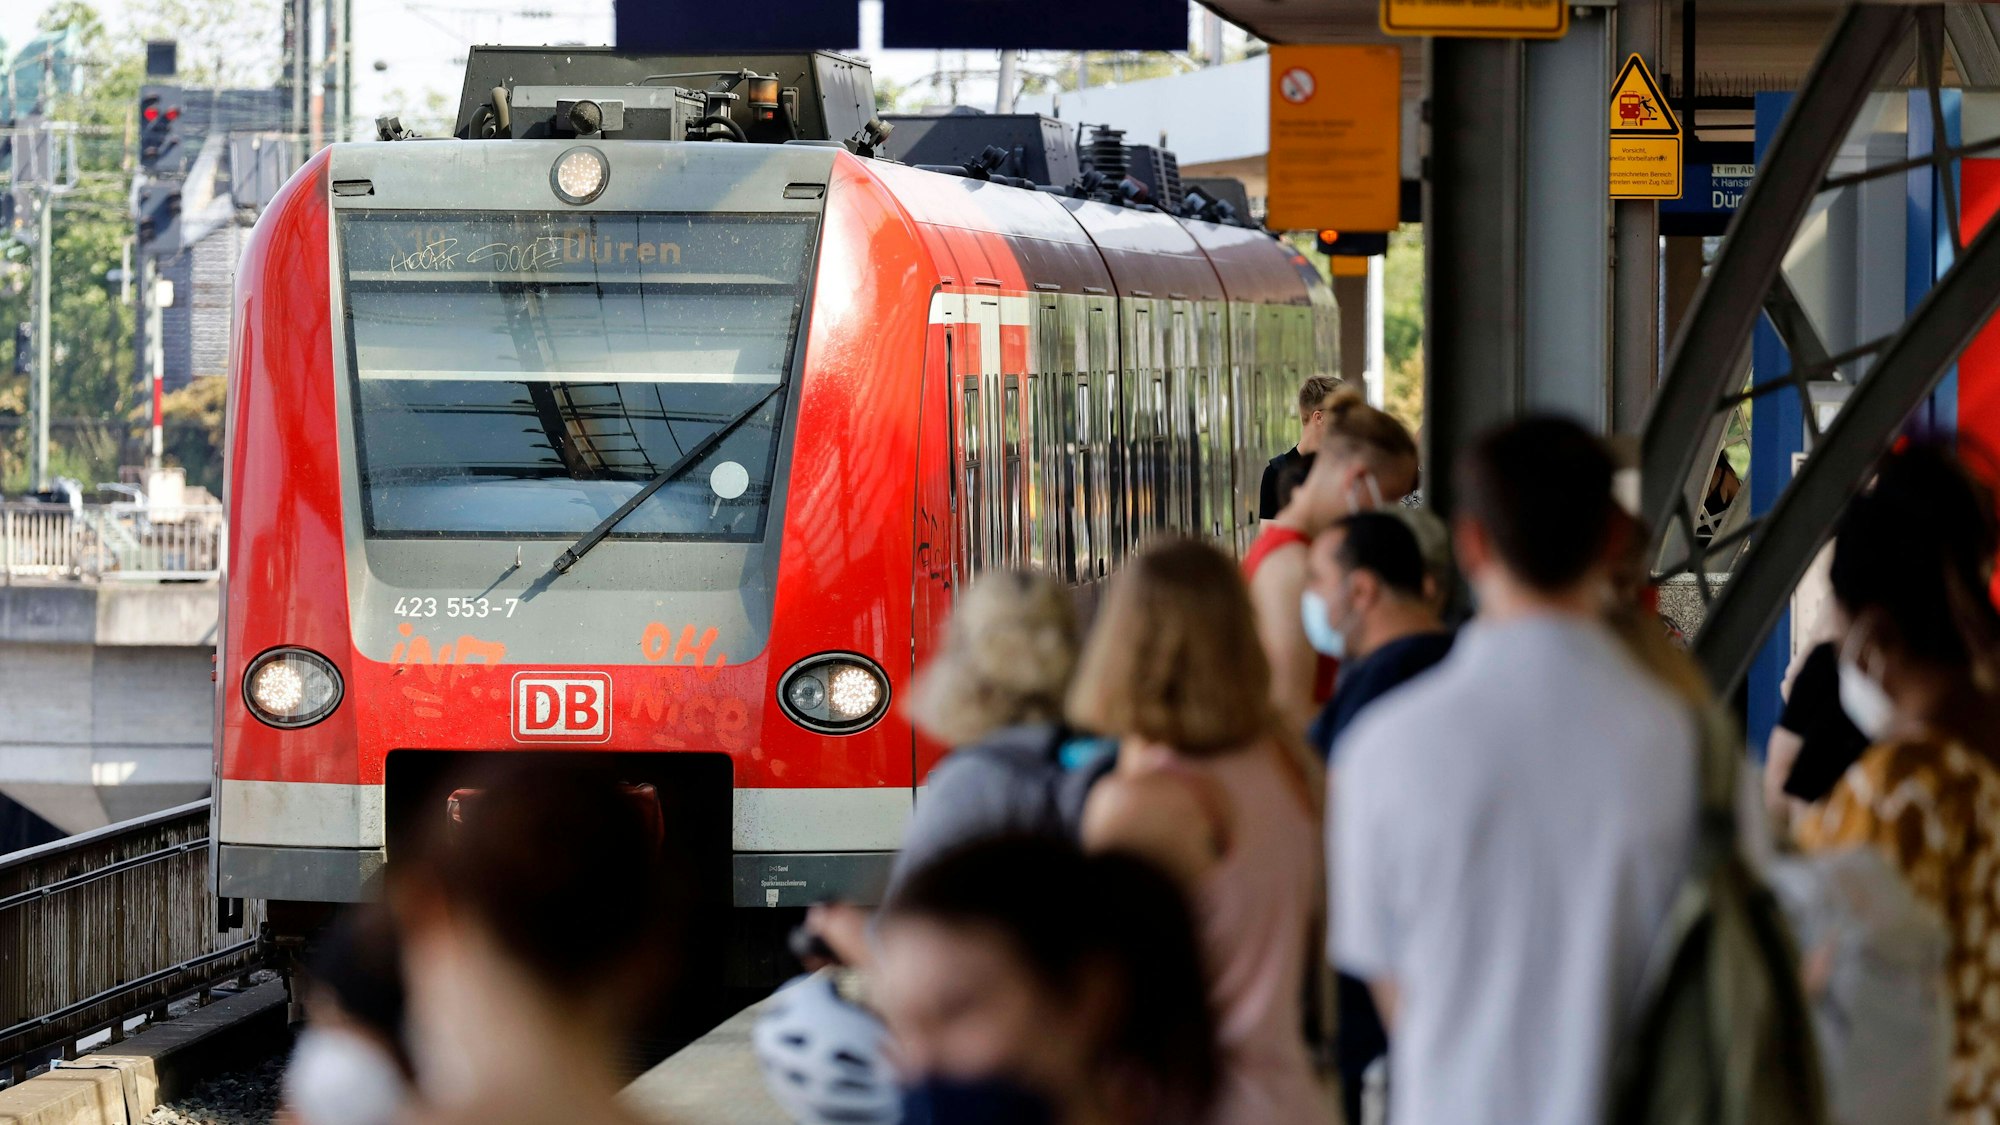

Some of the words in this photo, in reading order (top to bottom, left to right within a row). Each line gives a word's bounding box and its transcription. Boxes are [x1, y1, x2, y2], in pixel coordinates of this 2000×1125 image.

[1649, 179, 1660, 187] Zug
[563, 228, 681, 265] Düren
[394, 597, 437, 618] 423
[447, 597, 519, 618] 553-7
[522, 682, 601, 733] DB
